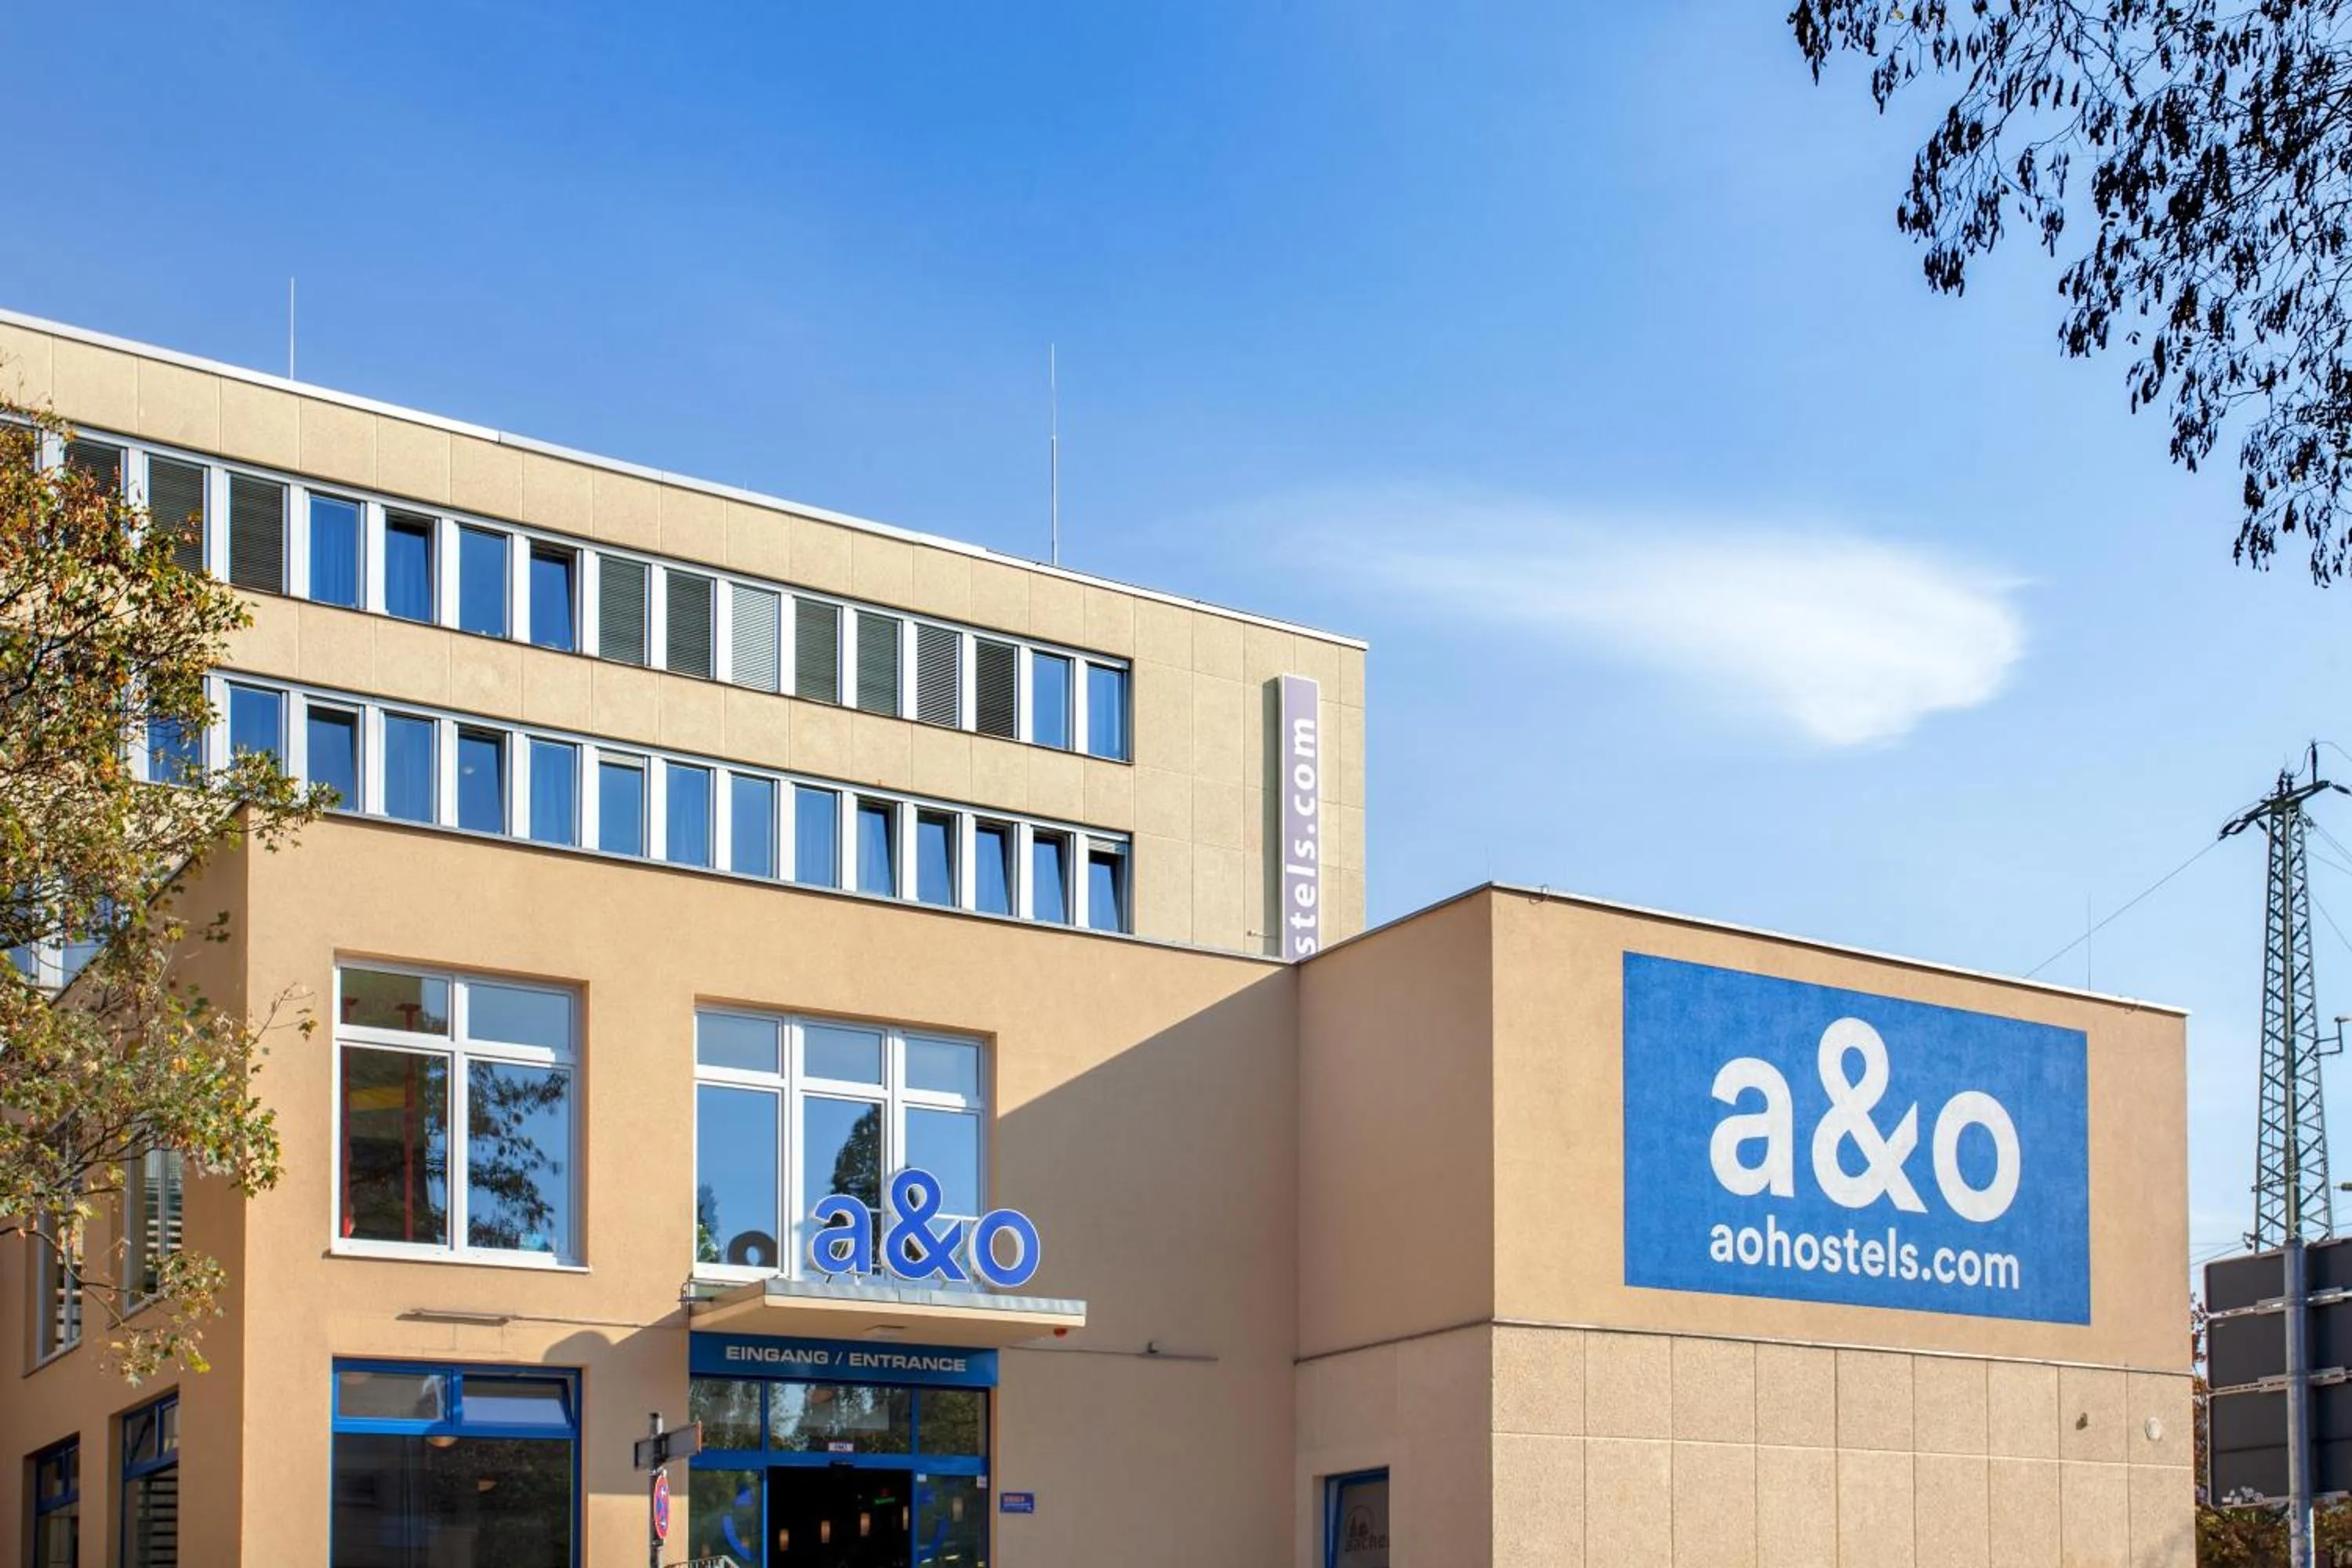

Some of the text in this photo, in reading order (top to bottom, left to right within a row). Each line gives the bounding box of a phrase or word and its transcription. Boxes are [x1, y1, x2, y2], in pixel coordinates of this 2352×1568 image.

[1709, 1016, 2021, 1223] a&o
[810, 1167, 1041, 1288] a&o
[1709, 1215, 2020, 1290] aohostels.com
[725, 1345, 829, 1365] EINGANG
[849, 1352, 967, 1372] ENTRANCE
